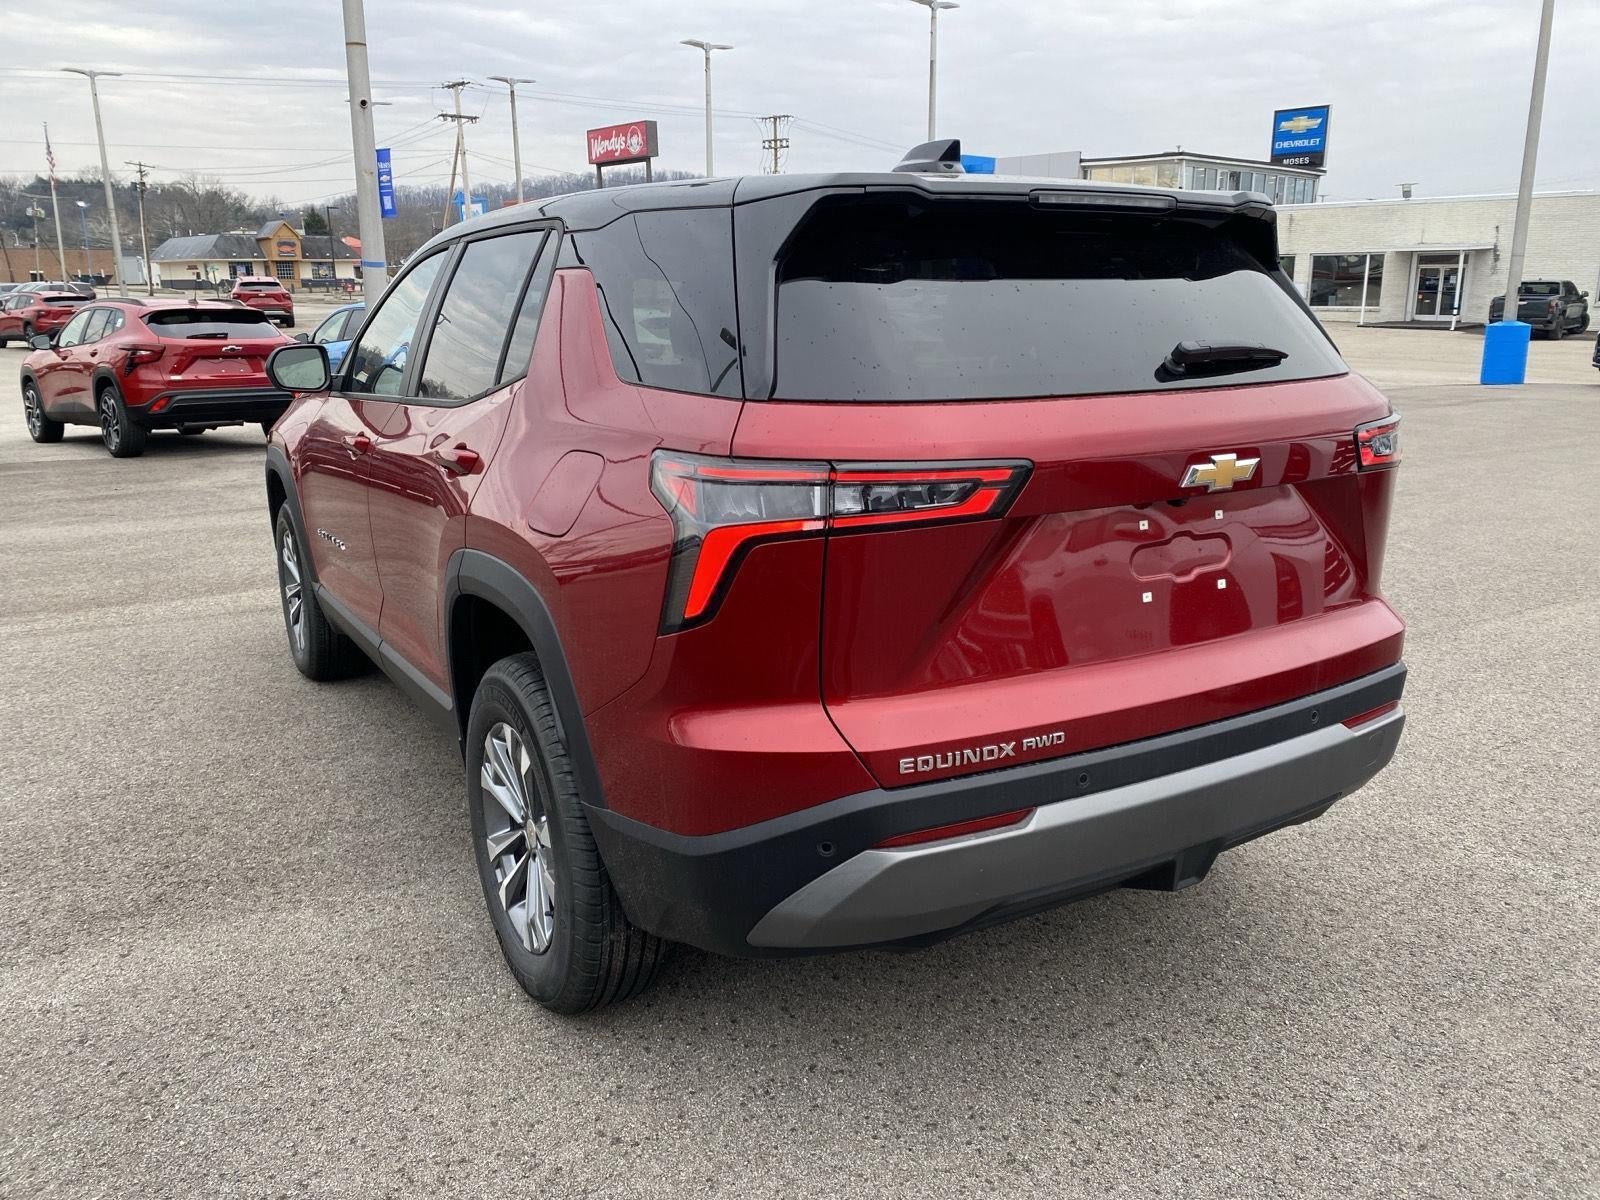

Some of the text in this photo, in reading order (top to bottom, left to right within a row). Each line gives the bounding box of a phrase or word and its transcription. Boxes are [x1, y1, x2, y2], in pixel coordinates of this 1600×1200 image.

[591, 129, 626, 160] Wendy's
[1275, 138, 1321, 149] CHEVROLET
[1283, 157, 1310, 165] MOSES
[899, 732, 1066, 775] EQUINOX AWD
